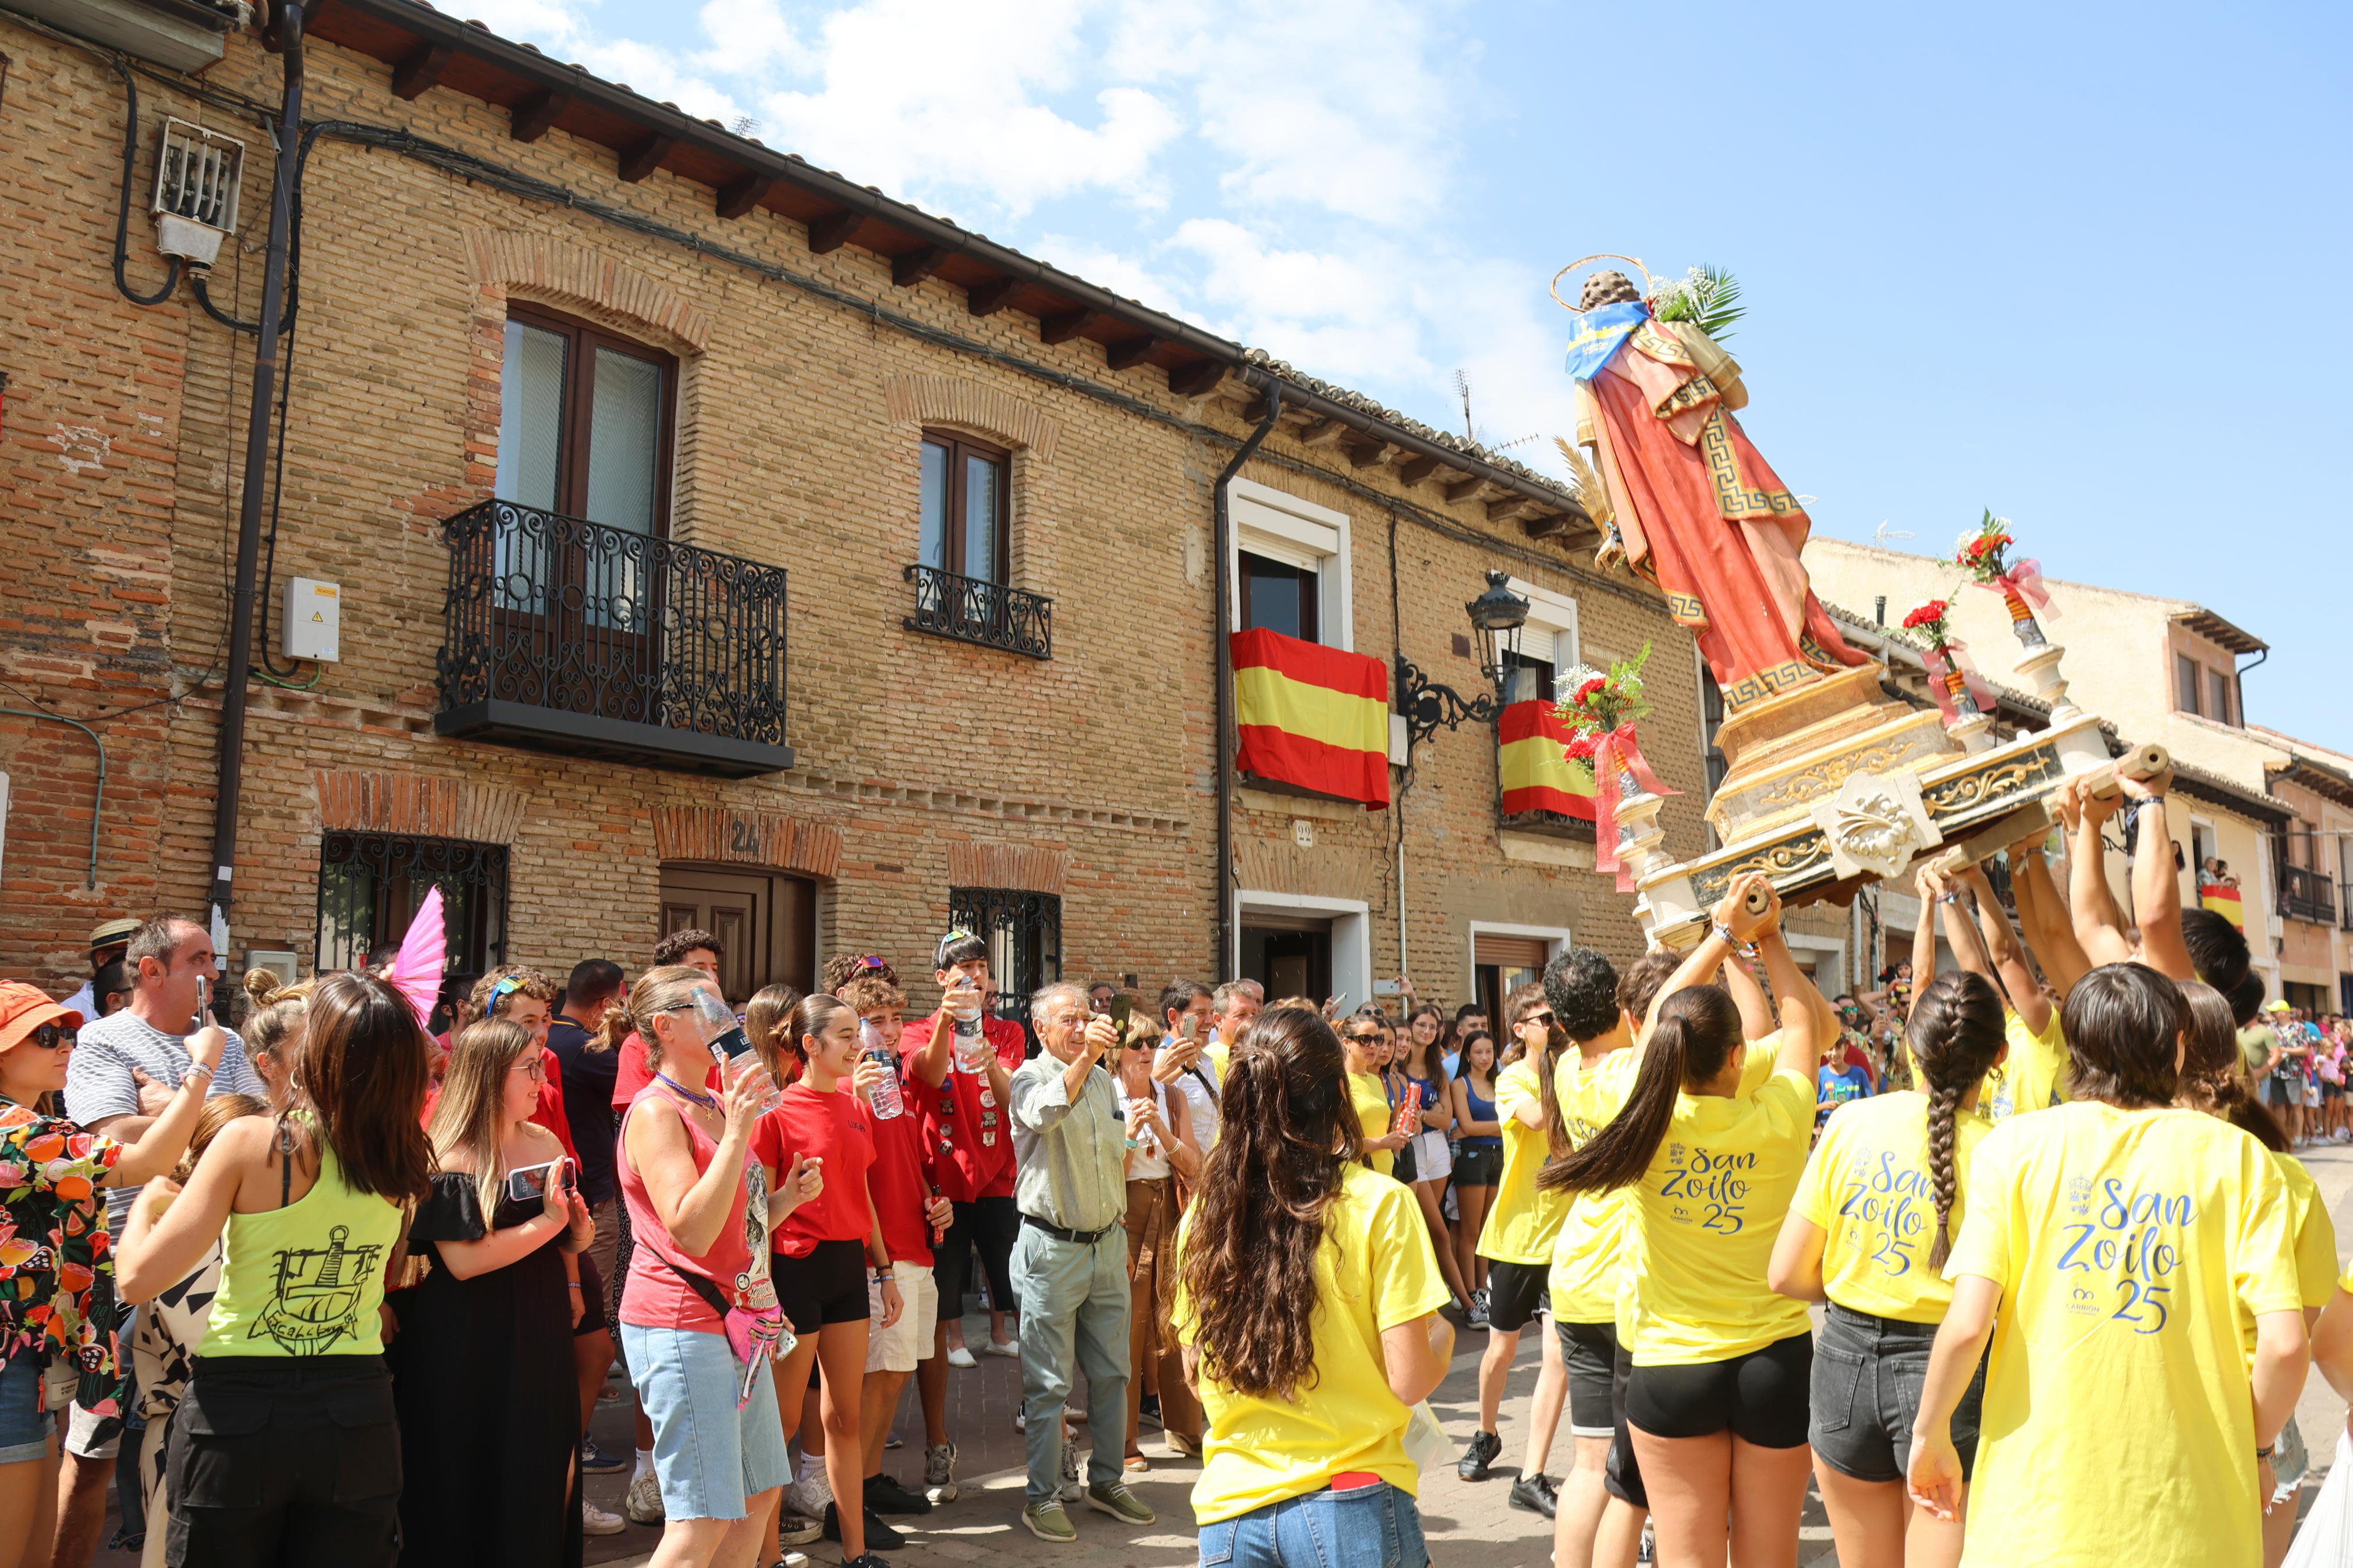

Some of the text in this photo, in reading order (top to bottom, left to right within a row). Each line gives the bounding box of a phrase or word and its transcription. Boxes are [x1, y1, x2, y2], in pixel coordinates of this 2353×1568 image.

[732, 820, 758, 856] 24
[1298, 825, 1311, 841] 22
[1691, 1147, 1760, 1174] San
[1660, 1169, 1752, 1205] Zoilo
[2100, 1178, 2199, 1231] San
[1702, 1203, 1745, 1235] 25
[1839, 1183, 1928, 1239] Zoilo
[1871, 1232, 1915, 1277] 25
[2057, 1224, 2182, 1282] Zoilo
[2111, 1279, 2171, 1334] 25
